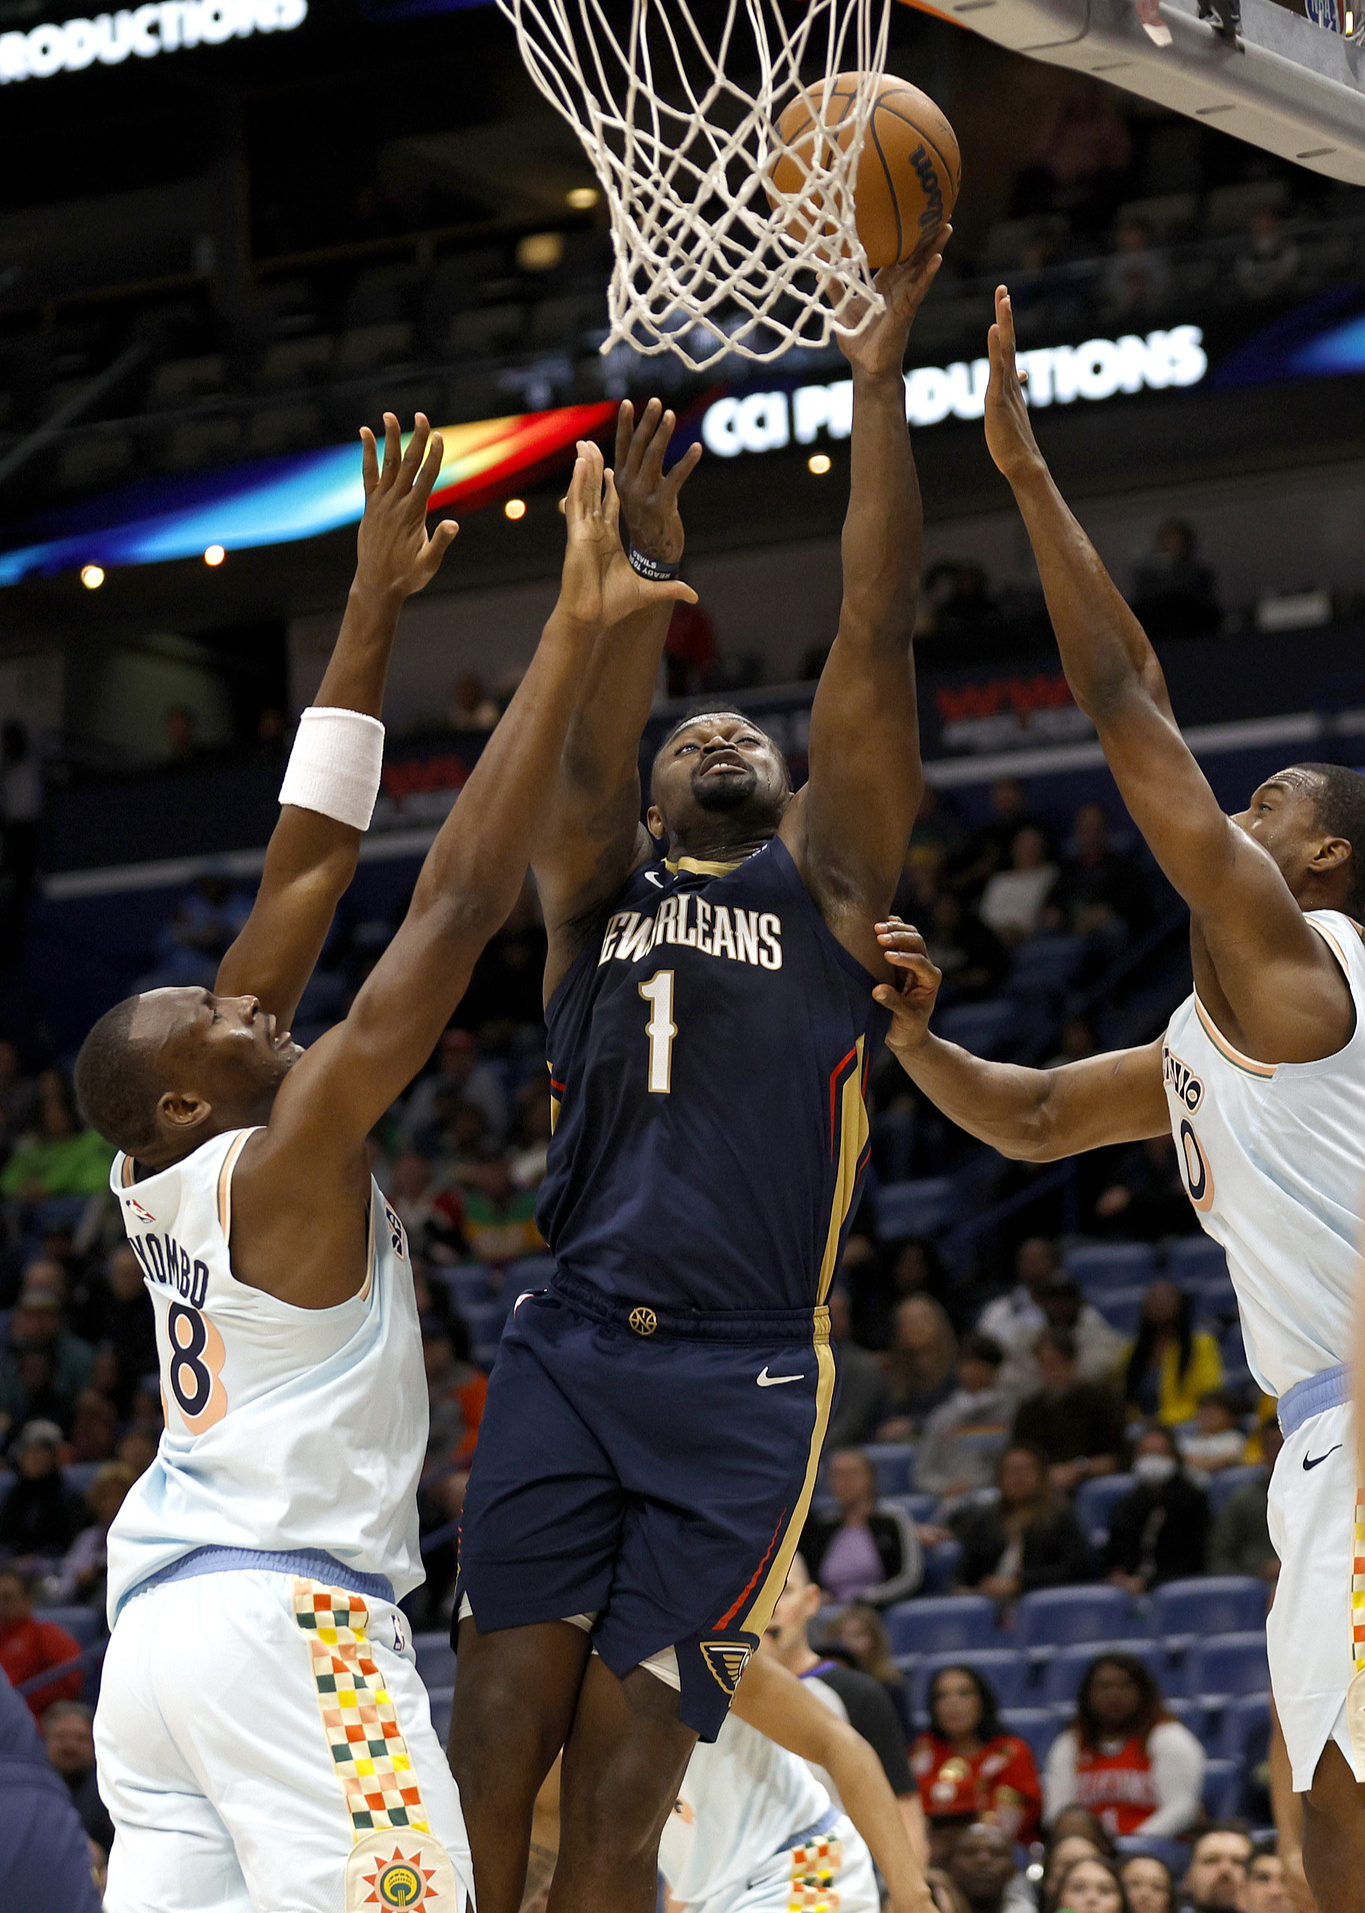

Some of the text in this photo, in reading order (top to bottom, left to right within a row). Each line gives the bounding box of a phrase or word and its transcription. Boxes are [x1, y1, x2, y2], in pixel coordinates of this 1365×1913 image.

[795, 326, 1208, 443] PRDUTIONS
[650, 893, 783, 971] RLEANS
[638, 970, 678, 1094] 1
[168, 1301, 218, 1422] 8
